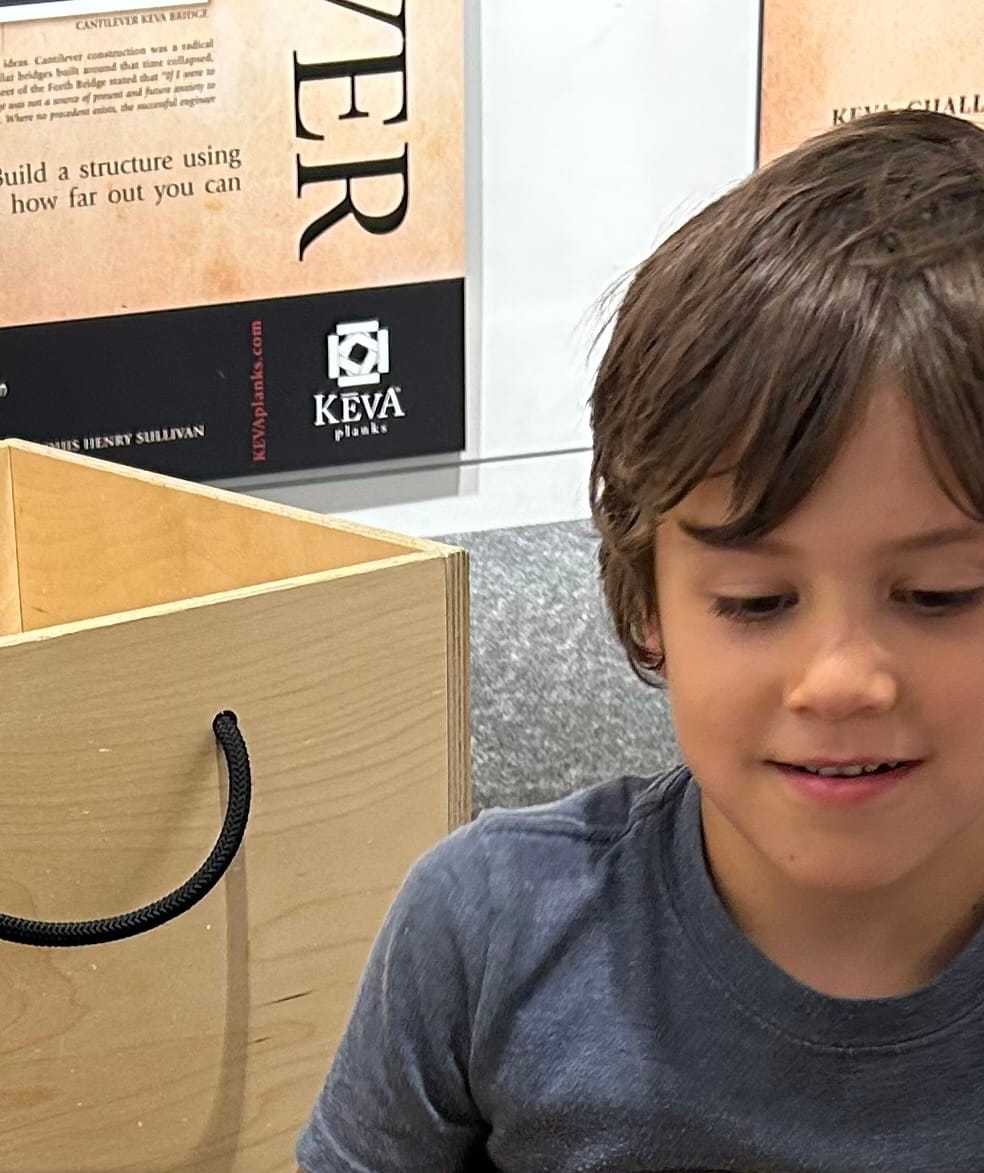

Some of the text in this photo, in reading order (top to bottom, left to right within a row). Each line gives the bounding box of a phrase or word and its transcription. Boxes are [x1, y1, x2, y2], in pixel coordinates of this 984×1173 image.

[76, 9, 208, 30] CANTILEVER KEVA BRIDGE
[34, 53, 82, 65] Cantilever
[87, 48, 146, 60] construction
[172, 44, 178, 52] a
[181, 38, 214, 51] radical
[17, 69, 53, 81] bridges
[56, 66, 79, 77] built
[83, 62, 117, 74] around
[119, 61, 139, 71] that
[142, 59, 162, 68] time
[17, 85, 28, 95] of
[30, 84, 45, 93] the
[48, 80, 73, 92] Forth
[76, 78, 106, 89] Bridge
[109, 73, 137, 86] stated
[140, 73, 158, 82] that
[183, 70, 203, 78] were
[206, 68, 216, 76] to
[6, 113, 34, 123] Where
[36, 112, 48, 120] no
[49, 107, 90, 122] precedent
[120, 102, 134, 112] the
[136, 97, 178, 110] successful
[179, 96, 217, 108] engineer
[8, 101, 25, 110] was
[27, 99, 42, 107] not
[44, 98, 51, 106] a
[53, 96, 80, 105] source
[81, 92, 91, 104] of
[93, 91, 123, 103] present
[125, 86, 143, 98] and
[145, 86, 171, 98] future
[206, 82, 216, 90] to
[58, 166, 69, 181] a
[79, 154, 174, 179] structure
[183, 145, 242, 169] using
[11, 176, 241, 214] how far out you can
[250, 320, 268, 461] KEVAplanks.com
[83, 433, 133, 450] HENRY
[135, 424, 206, 444] SULLIVAN
[334, 421, 388, 442] planks
